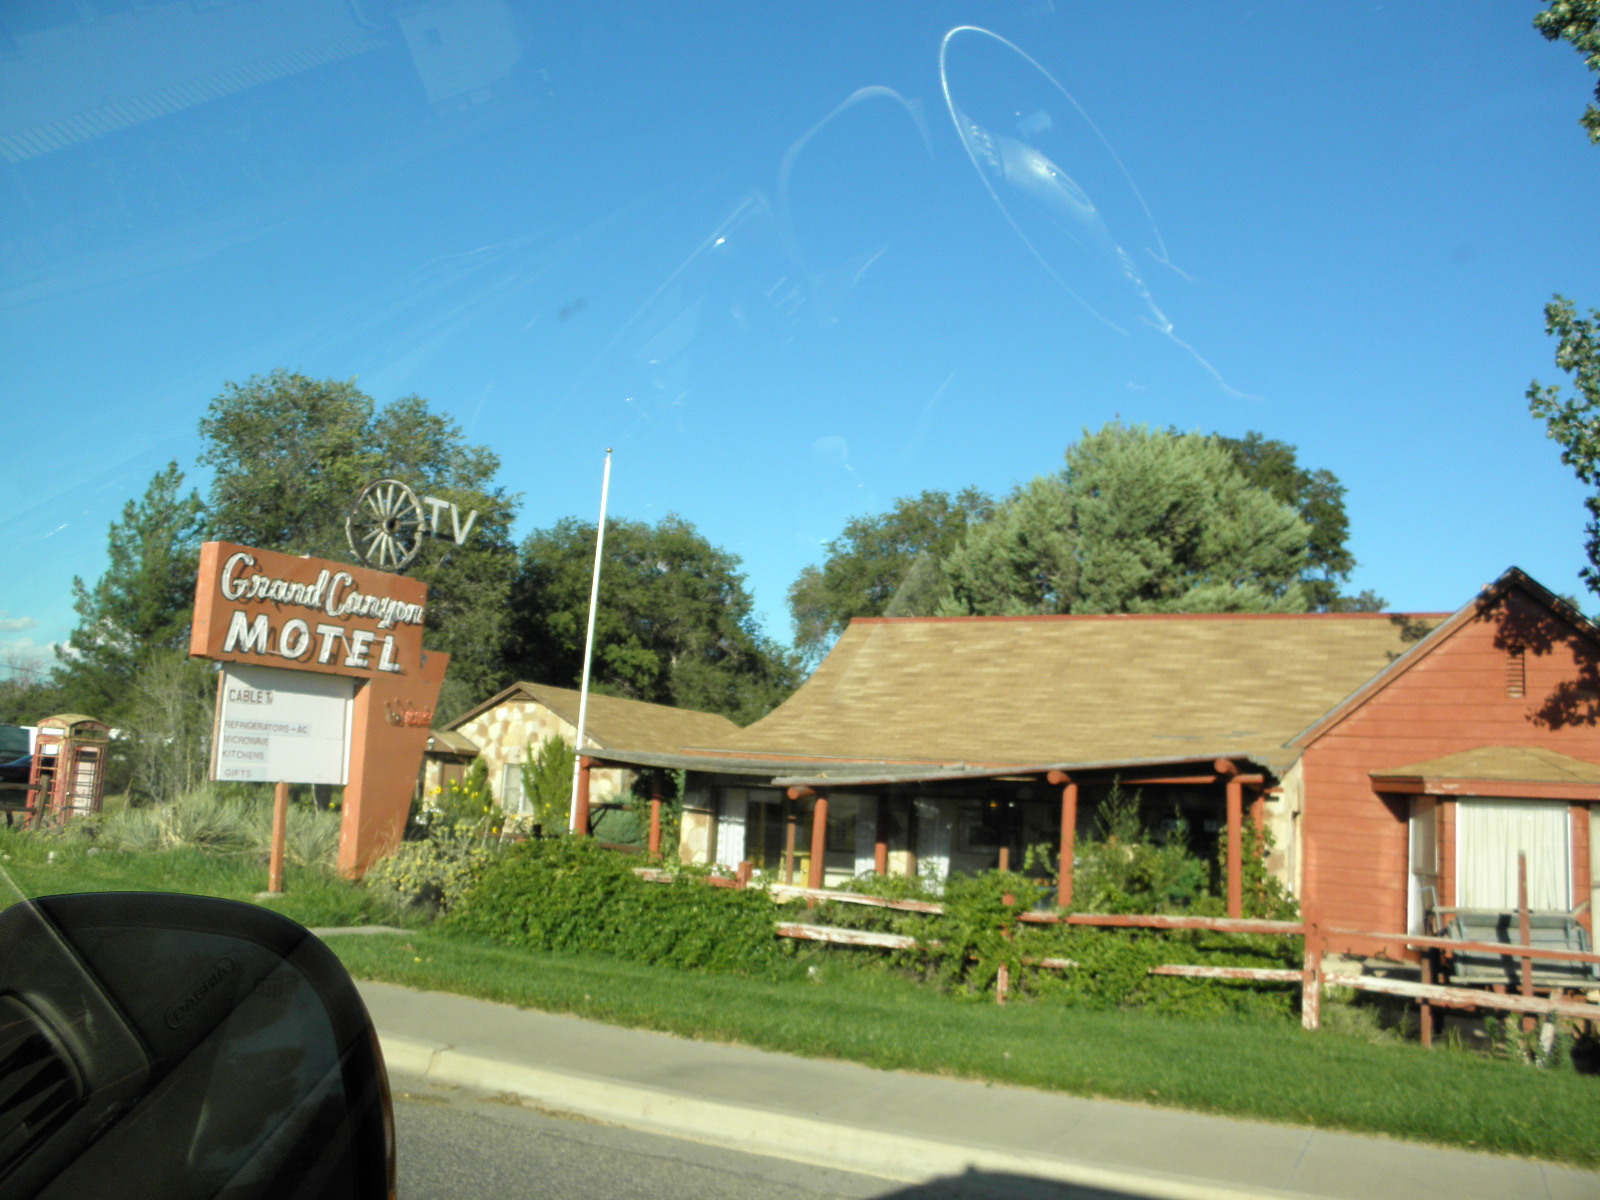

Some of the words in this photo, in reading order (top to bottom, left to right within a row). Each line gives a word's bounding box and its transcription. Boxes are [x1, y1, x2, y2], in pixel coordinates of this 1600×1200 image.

[424, 496, 478, 545] TV
[221, 552, 329, 608] Grand
[325, 571, 423, 629] Canyon
[223, 610, 401, 672] MOTEL
[229, 689, 262, 704] CABLE
[223, 734, 269, 746] MICROWAVE
[222, 749, 264, 760] KITCHENS
[224, 768, 251, 778] GIFTS
